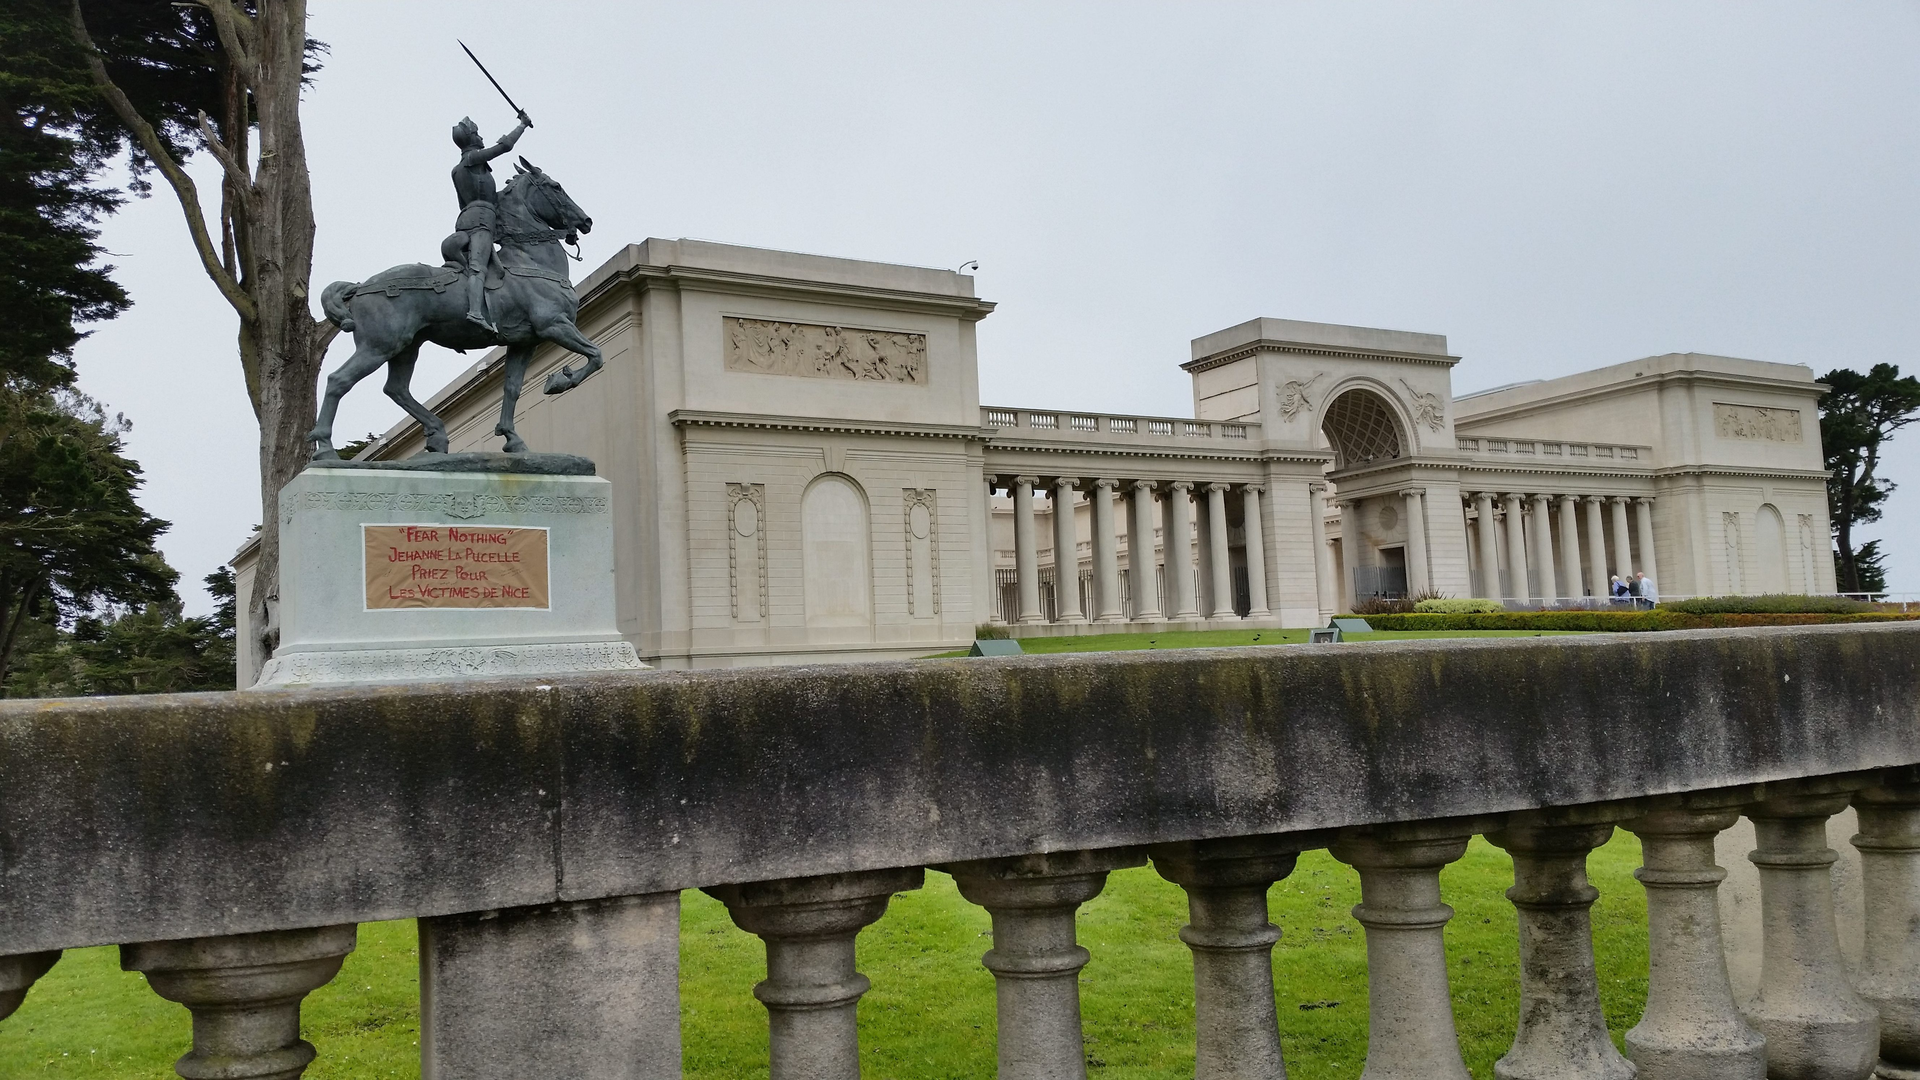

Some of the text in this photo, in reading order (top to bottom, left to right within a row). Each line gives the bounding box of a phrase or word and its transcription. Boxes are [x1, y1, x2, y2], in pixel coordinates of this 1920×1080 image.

[388, 546, 444, 562] JEHANNE
[465, 547, 521, 562] PUCELLE
[412, 564, 449, 580] PRIEZ
[417, 583, 480, 598] VICTIMES
[501, 585, 530, 599] NICE
